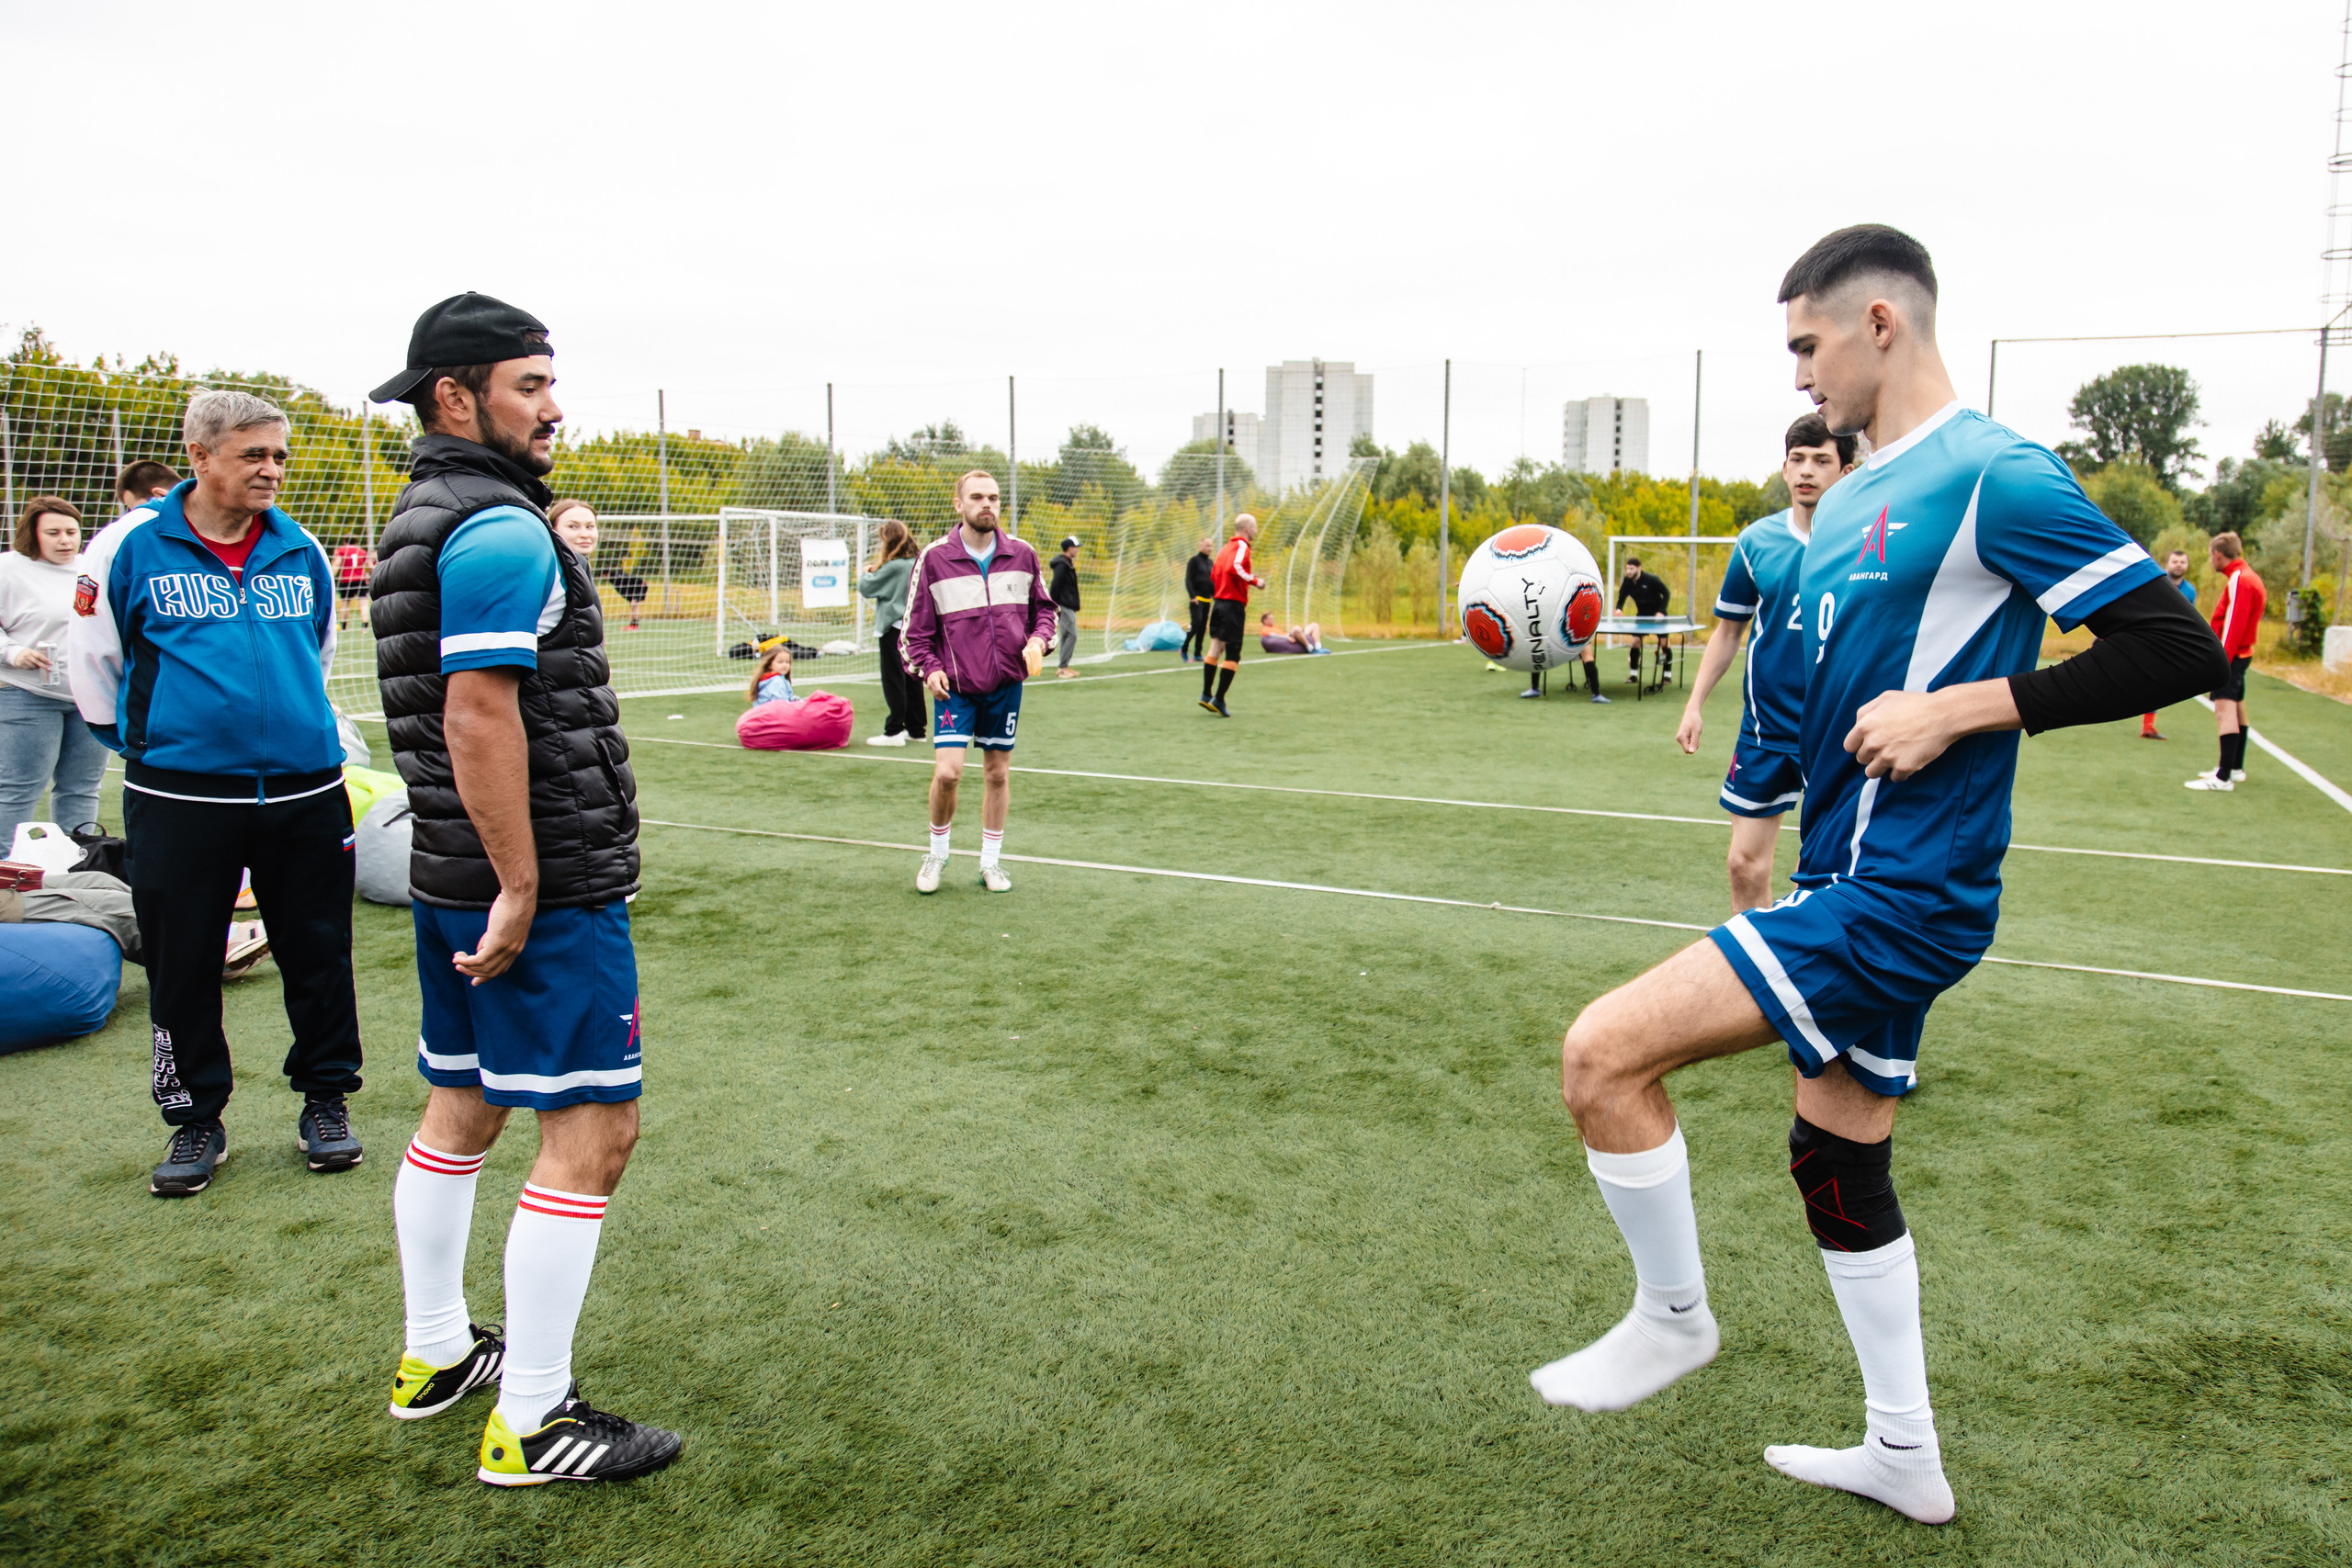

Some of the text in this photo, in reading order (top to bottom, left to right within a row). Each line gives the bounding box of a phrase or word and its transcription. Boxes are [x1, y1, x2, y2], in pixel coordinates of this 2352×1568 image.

[1849, 571, 1889, 581] АВАНГАРД
[1521, 577, 1547, 671] PENALTY
[1005, 712, 1017, 736] 5
